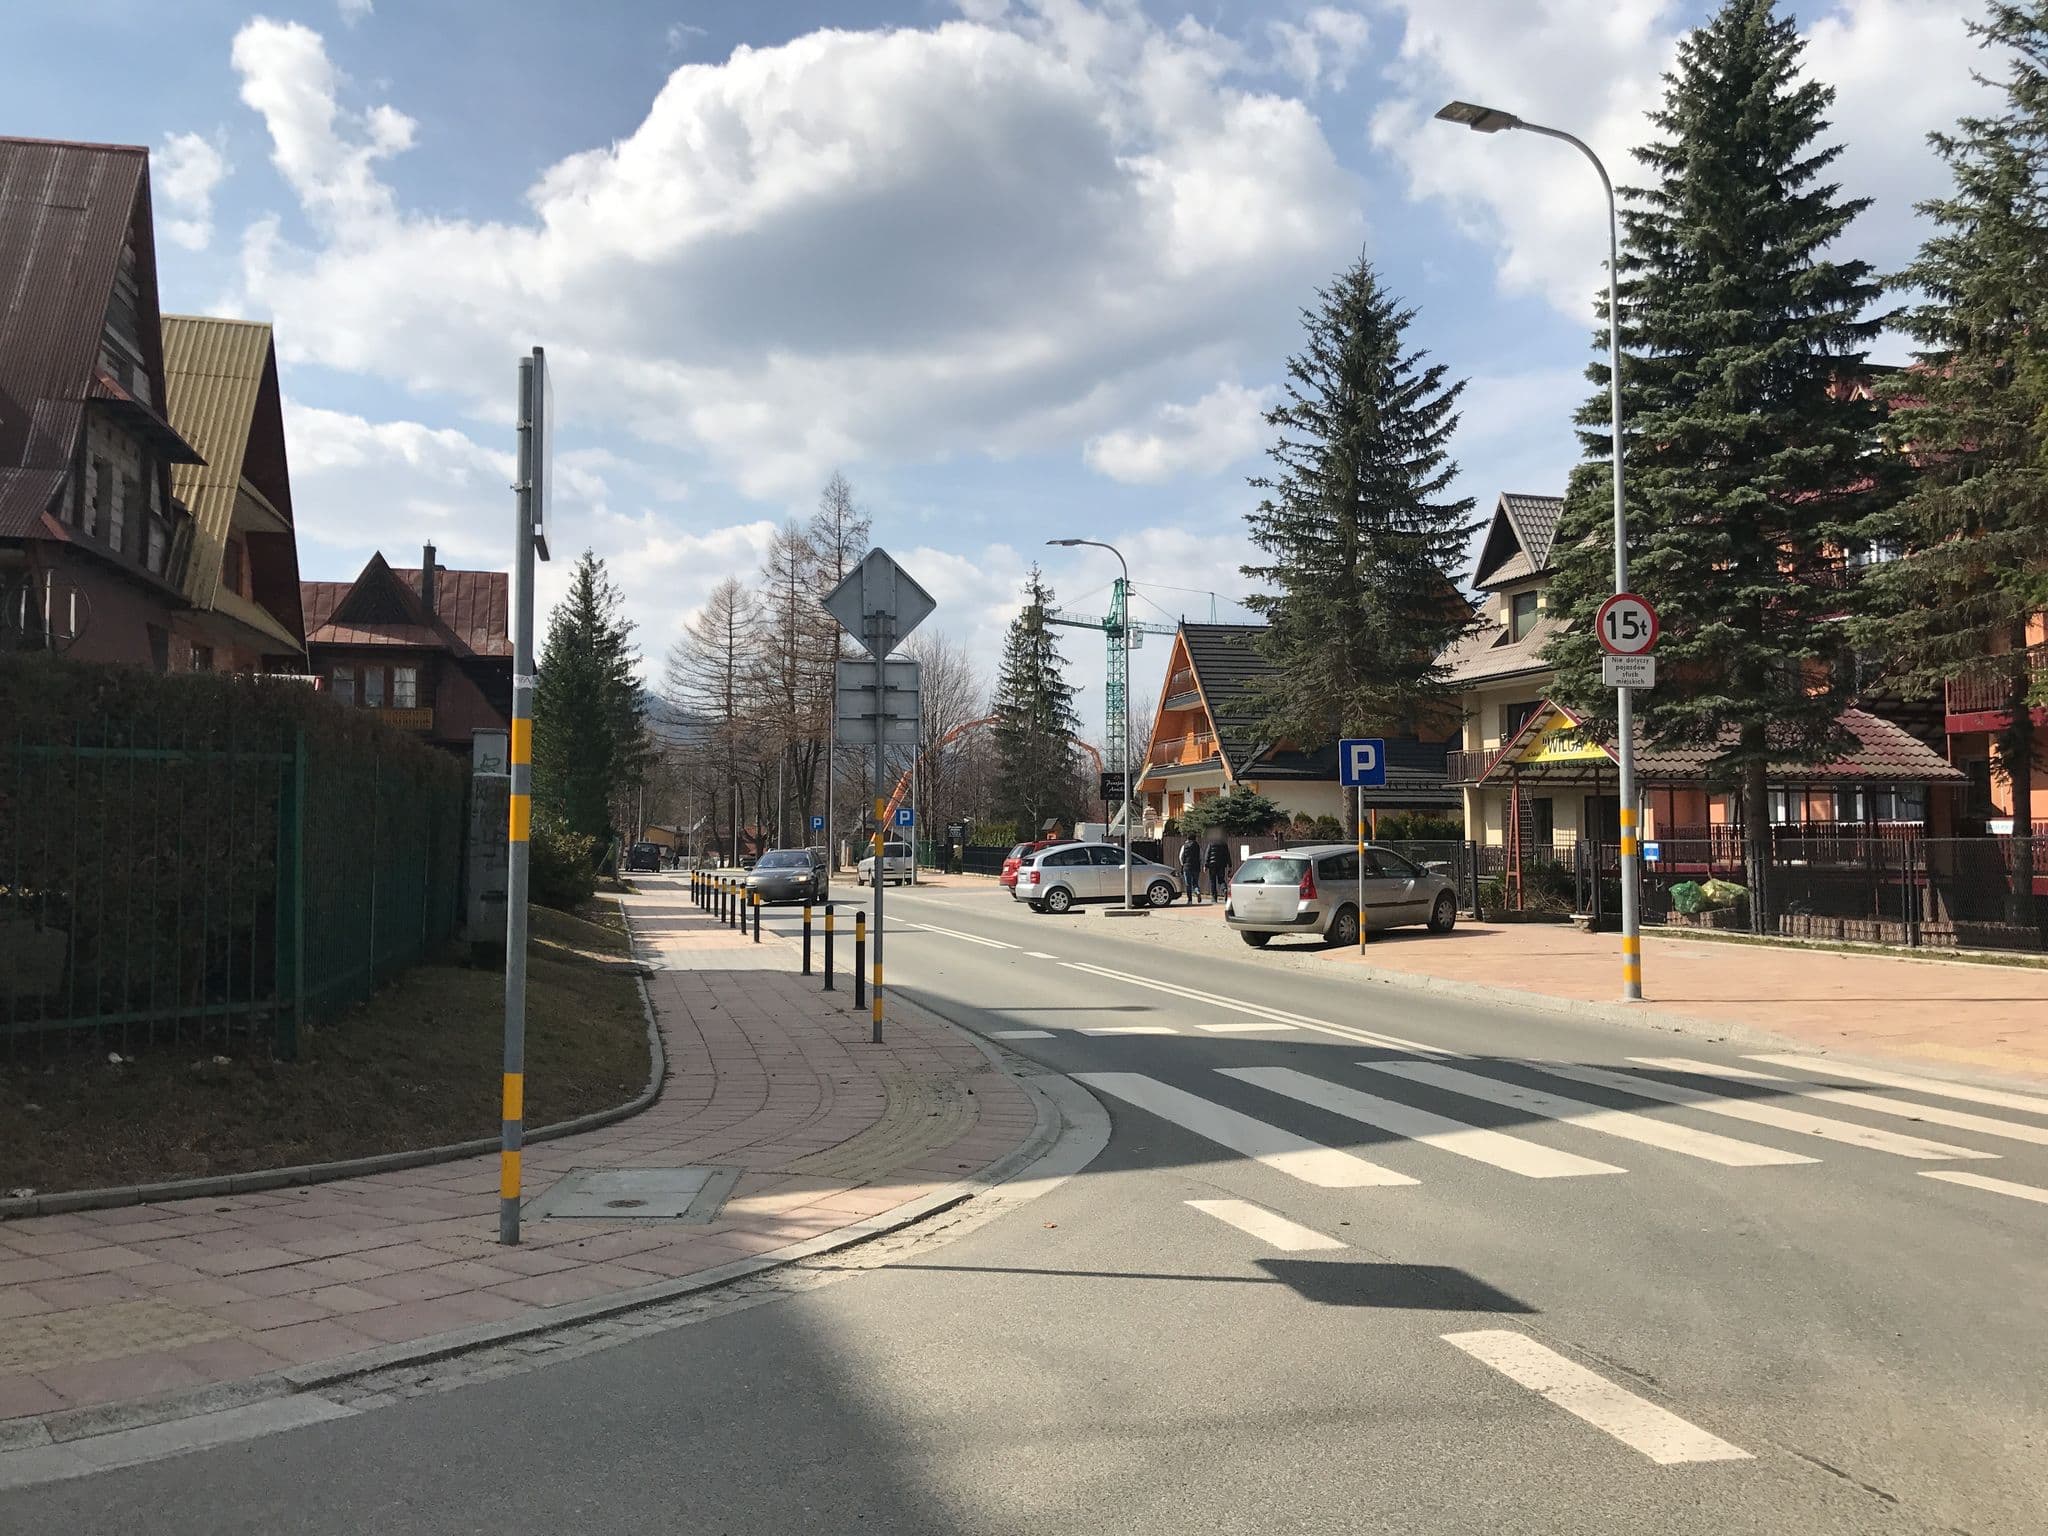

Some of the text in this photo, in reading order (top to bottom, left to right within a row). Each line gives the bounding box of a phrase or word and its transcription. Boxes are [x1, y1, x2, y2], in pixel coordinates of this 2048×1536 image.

[1626, 656, 1649, 665] dotyczy
[1351, 745, 1375, 780] P
[813, 817, 822, 828] P
[899, 810, 911, 824] P
